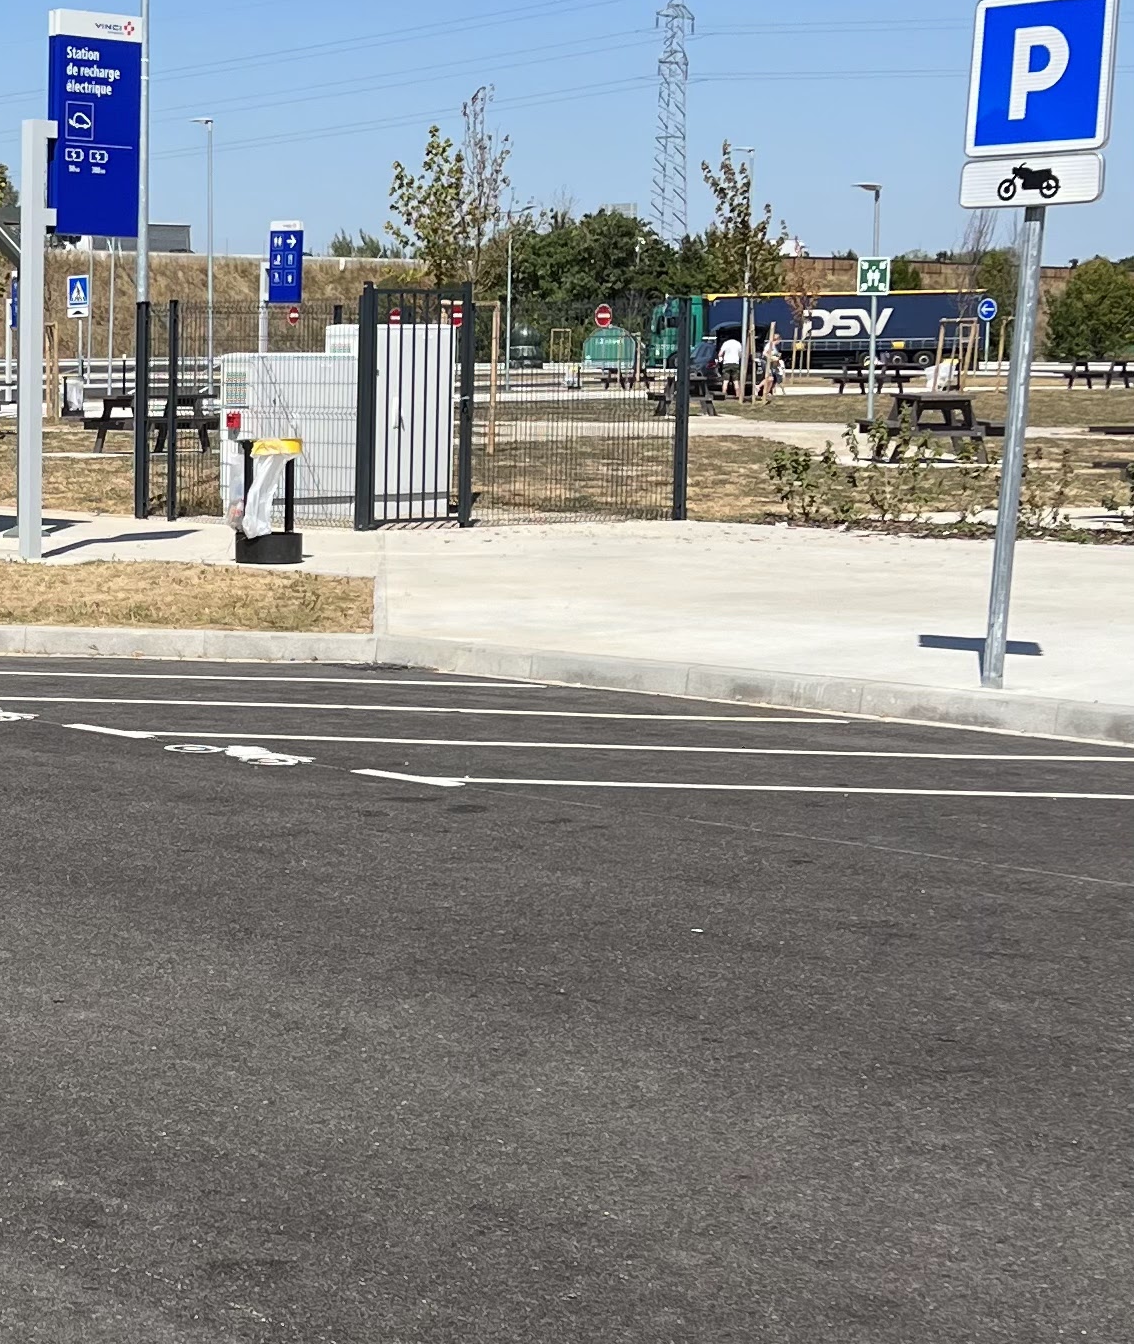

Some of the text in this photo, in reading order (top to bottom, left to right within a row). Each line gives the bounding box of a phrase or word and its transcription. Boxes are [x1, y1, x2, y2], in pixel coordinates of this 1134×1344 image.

[95, 22, 122, 31] VINCI
[67, 46, 100, 61] Station
[66, 62, 121, 82] de recharge
[1008, 25, 1070, 120] P
[66, 79, 112, 97] électrique
[801, 307, 894, 340] DSV
